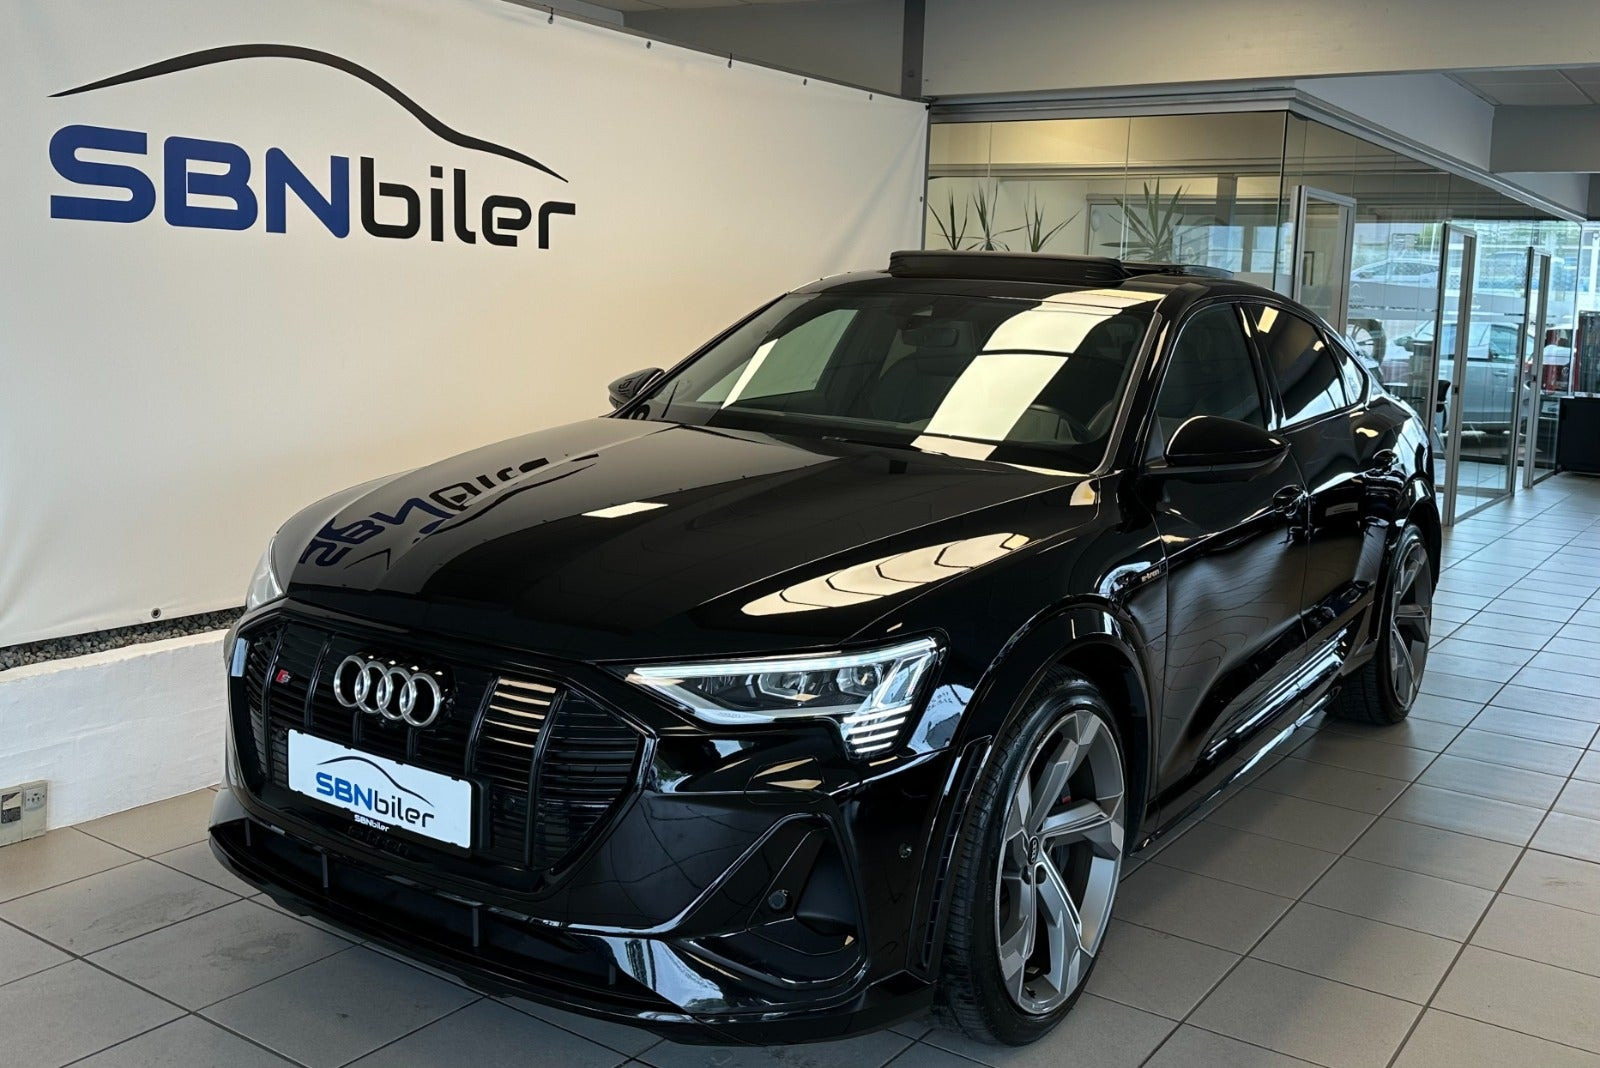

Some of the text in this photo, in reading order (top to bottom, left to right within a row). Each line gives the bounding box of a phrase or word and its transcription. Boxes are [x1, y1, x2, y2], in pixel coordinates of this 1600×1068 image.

[49, 124, 576, 249] SBNbiler
[316, 771, 434, 828] SBNbiler
[354, 814, 389, 832] SBNbiler
